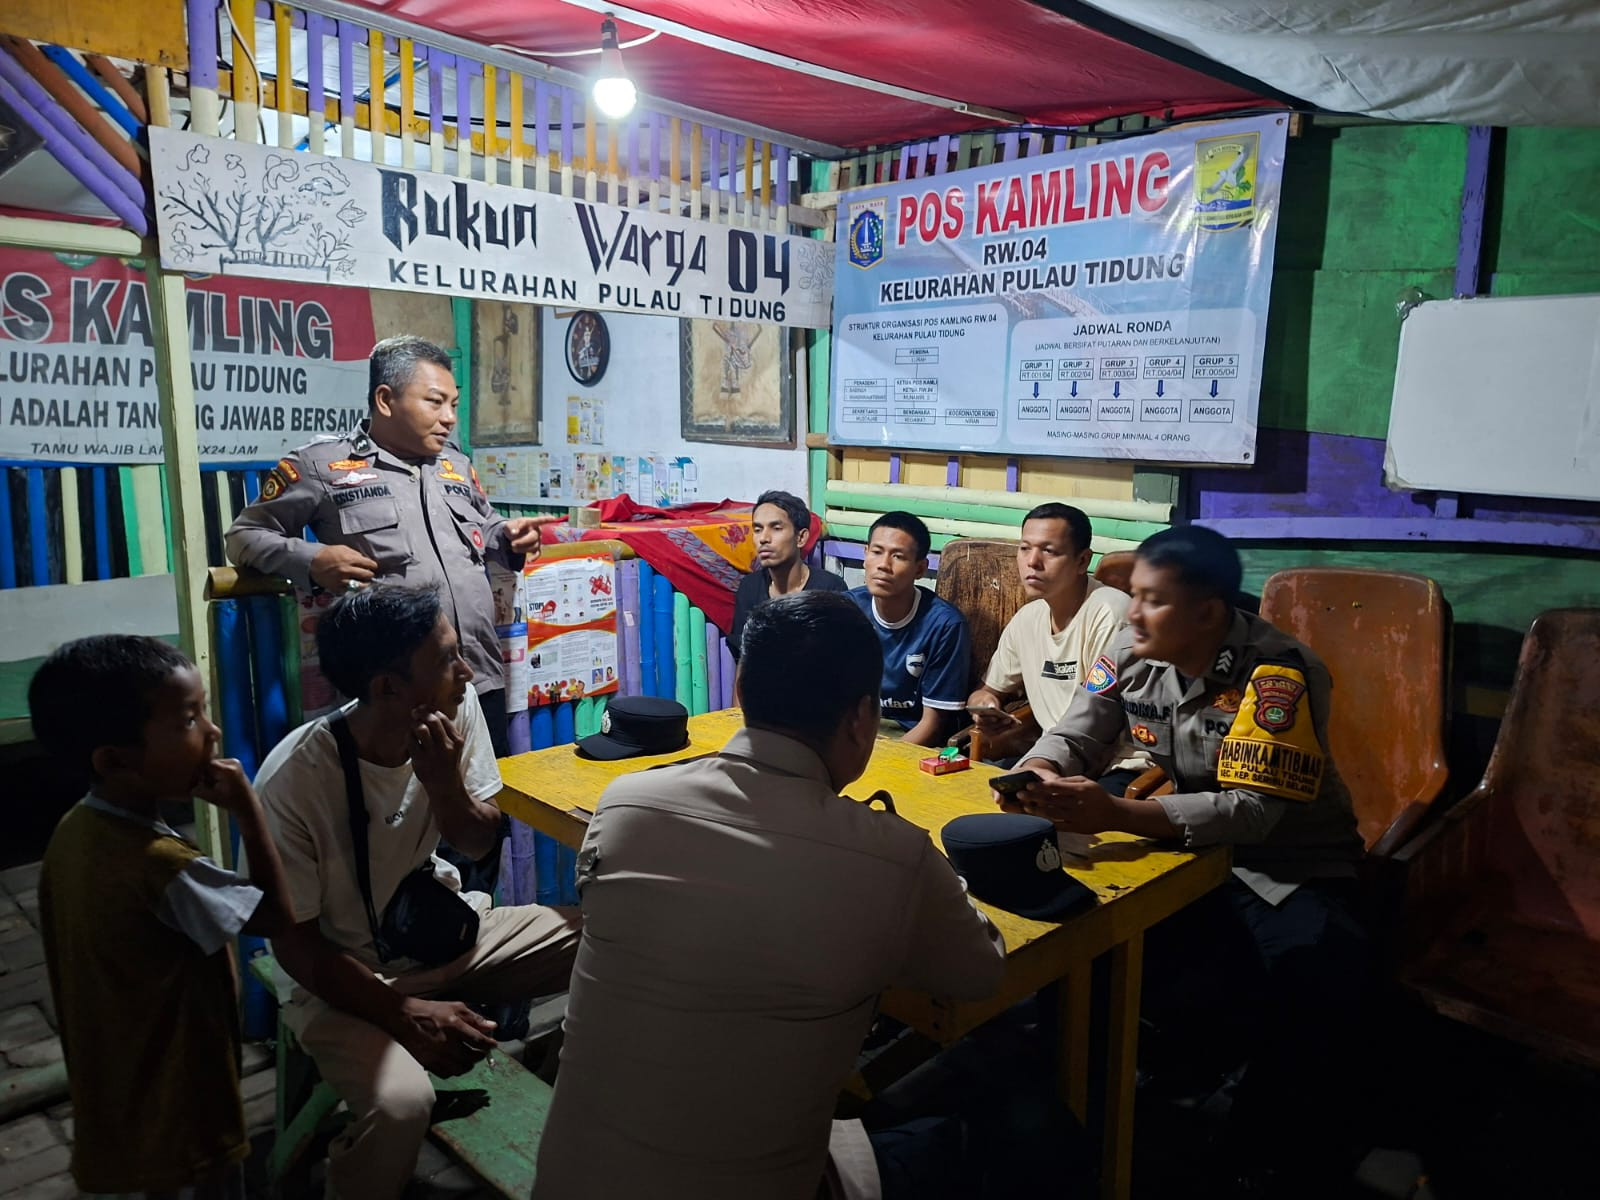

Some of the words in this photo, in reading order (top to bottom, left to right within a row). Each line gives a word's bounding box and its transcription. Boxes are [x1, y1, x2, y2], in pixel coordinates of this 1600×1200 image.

[898, 188, 964, 246] POS
[975, 151, 1171, 235] KAMLING
[376, 168, 537, 252] Rukun
[574, 202, 706, 287] Warga
[728, 229, 790, 296] 04
[983, 237, 1047, 266] RW.04
[388, 258, 577, 301] KELURAHAN
[599, 283, 681, 311] PULAU
[881, 273, 996, 302] KELURAHAN
[1002, 264, 1077, 292] PULAU
[1085, 253, 1185, 285] TIDUNG
[848, 321, 880, 331] STRUKTUR
[881, 319, 922, 329] ORGANISASI
[924, 318, 939, 327] POS
[940, 315, 973, 325] KAMLING
[1073, 322, 1123, 336] JADWAL
[1127, 320, 1172, 333] RONDA
[872, 332, 913, 341] KELURAHAN
[914, 330, 937, 339] PULAU
[939, 328, 965, 338] TIDUNG
[1063, 340, 1096, 350] BERSIFAT
[1098, 339, 1132, 349] PUTARAN
[1133, 339, 1148, 347] DAN
[1199, 357, 1224, 365] GRUP
[224, 364, 307, 394] TIDUNG
[10, 398, 108, 428] ADALAH
[220, 405, 285, 431] JAWAB
[291, 407, 369, 432] BERSAM
[1060, 406, 1090, 414] ANGGOTA
[1101, 406, 1131, 414] ANGGOTA
[1145, 407, 1178, 415] ANGGOTA
[1194, 407, 1231, 415] ANGGOTA
[1046, 431, 1100, 440] MASING-MASING
[1101, 432, 1120, 440] GRUP
[1122, 432, 1153, 441] MINIMAL
[1160, 433, 1191, 442] ORANG
[31, 442, 79, 455] TAMU
[84, 444, 134, 456] WAJIB
[229, 445, 258, 455] JAM
